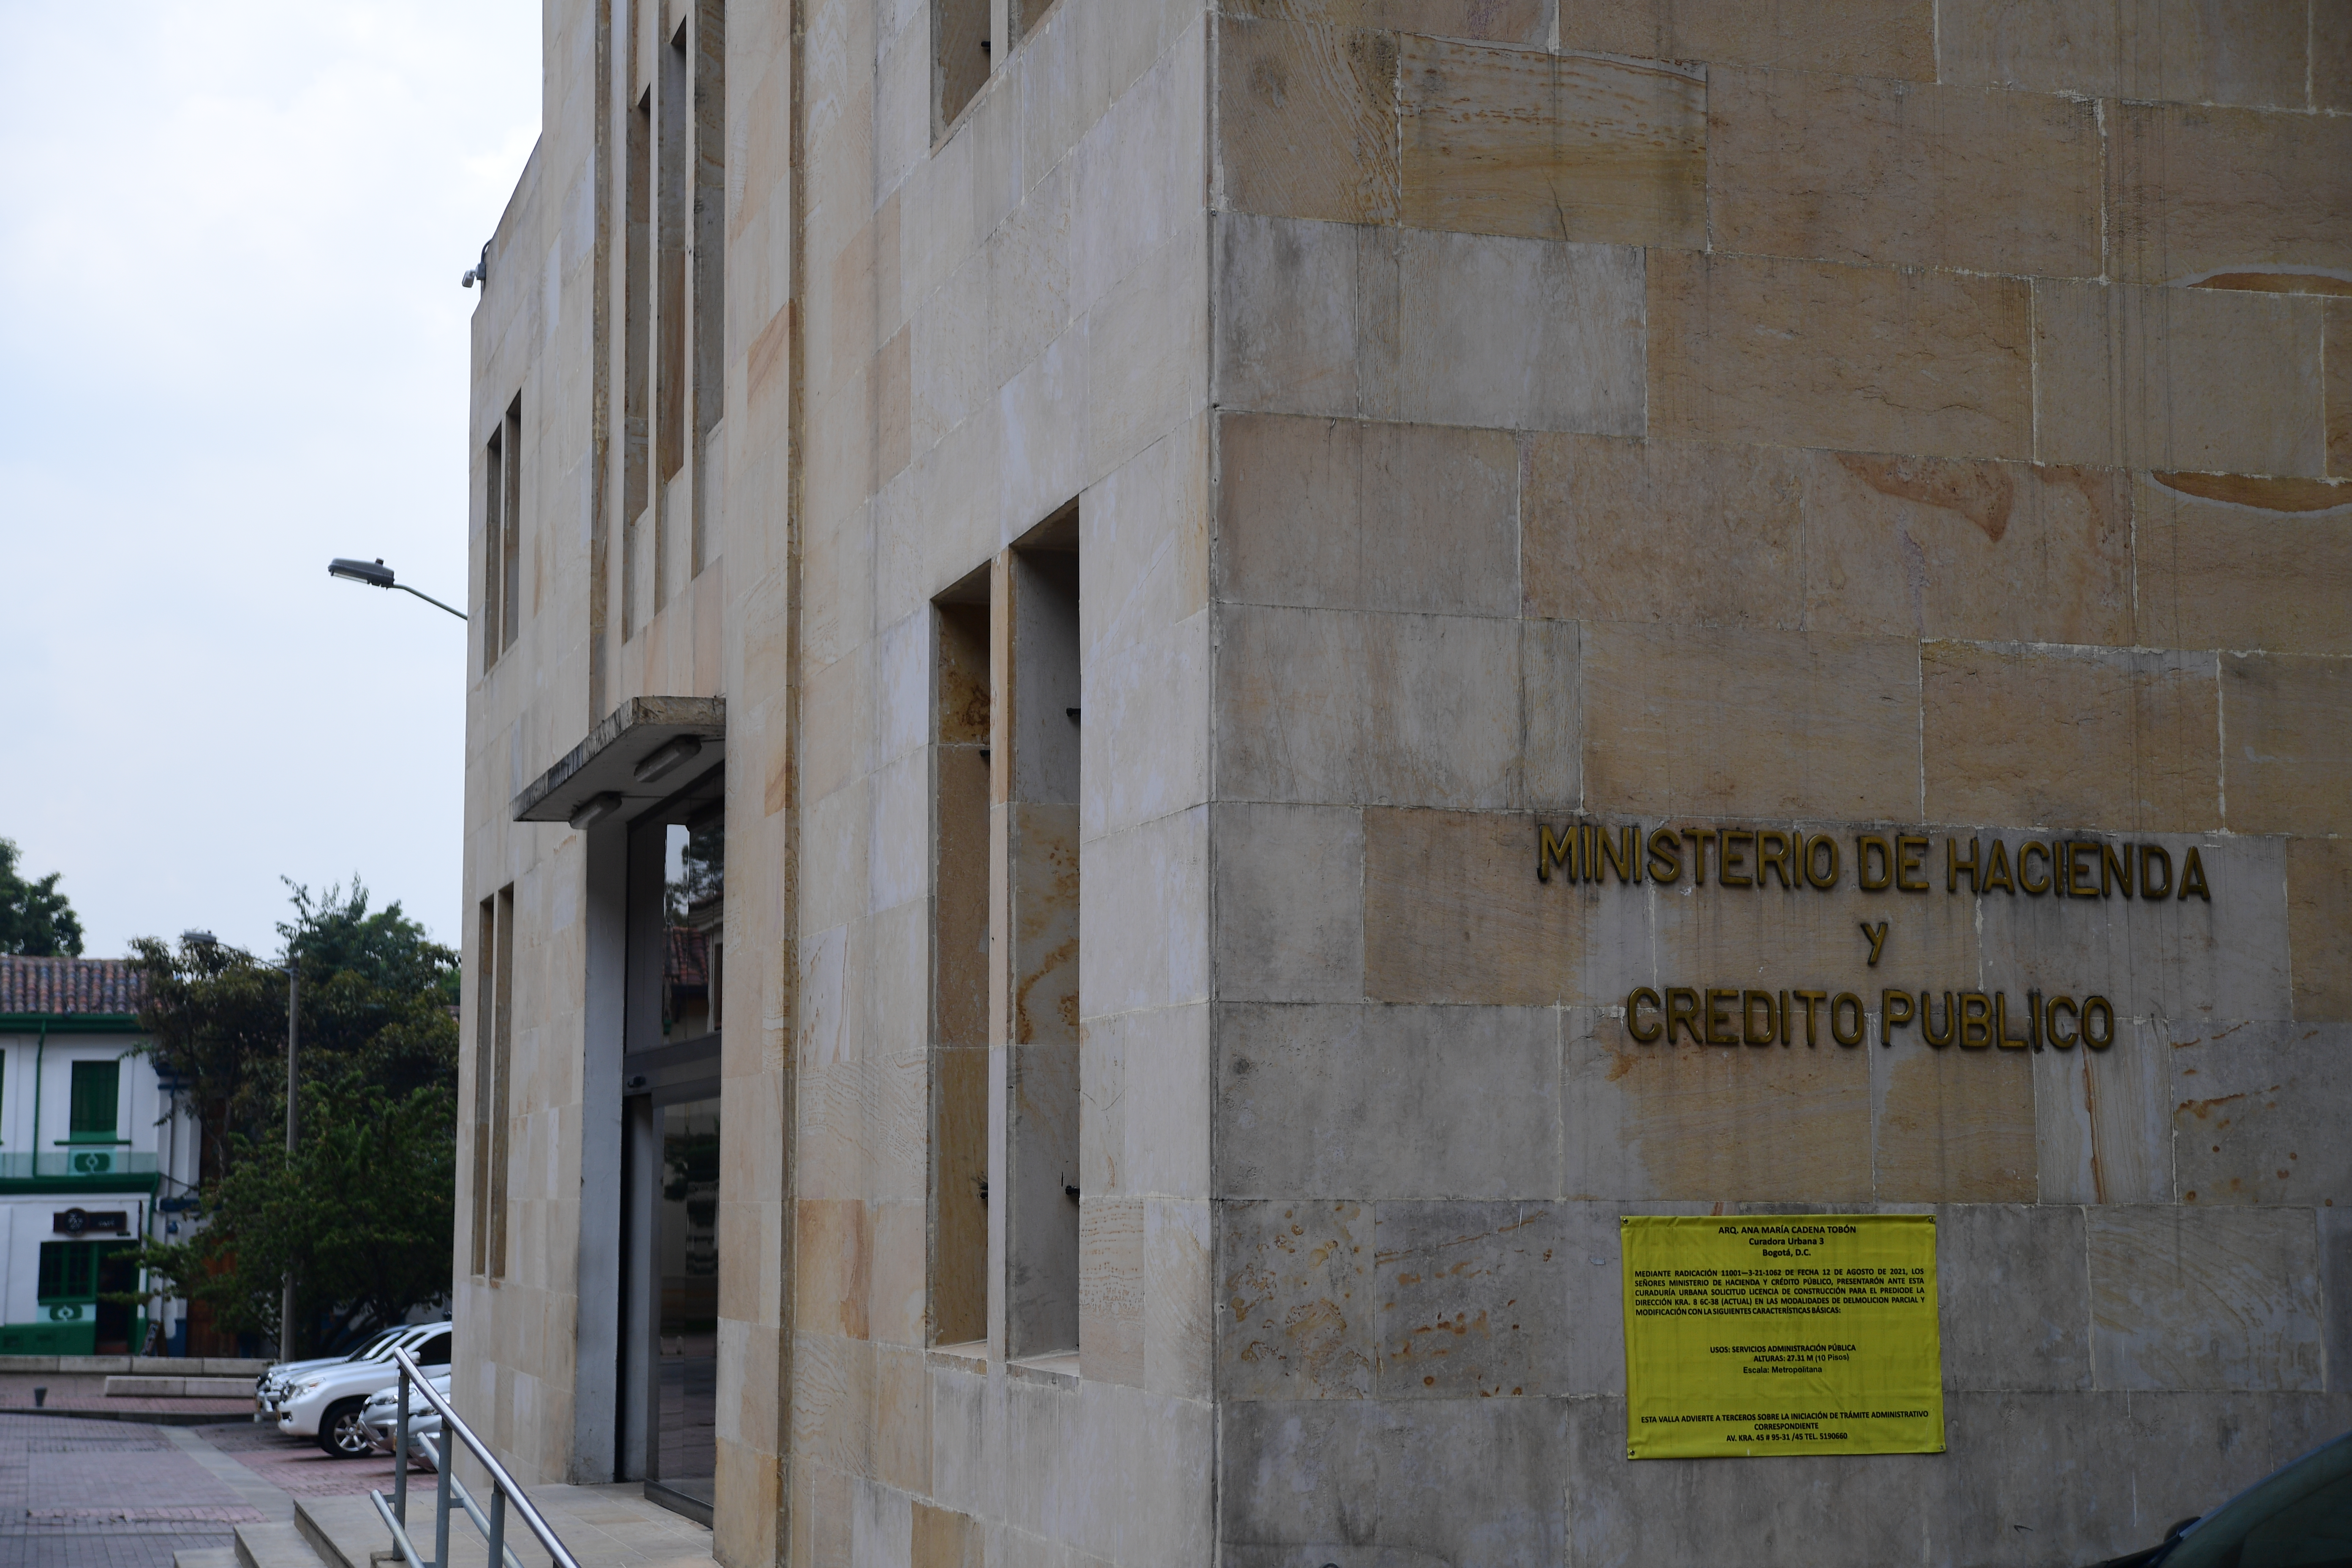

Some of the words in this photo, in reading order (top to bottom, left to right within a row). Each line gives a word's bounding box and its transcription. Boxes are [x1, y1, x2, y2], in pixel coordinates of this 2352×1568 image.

[1538, 824, 1840, 886] MINISTERIO
[1859, 835, 1930, 889] DE
[1948, 837, 2210, 900] HACIENDA
[1628, 986, 1864, 1046] CREDITO
[1881, 988, 2114, 1051] PUBLICO
[1718, 1226, 1739, 1235] ARQ.
[1761, 1225, 1790, 1234] MARÍA
[1827, 1224, 1856, 1233] TOBÓN
[1749, 1237, 1786, 1245] Curadora
[1788, 1237, 1817, 1245] Urbana
[1762, 1248, 1793, 1258] Bogotá,
[1675, 1269, 1718, 1277] RADICACIÓN
[1635, 1279, 1666, 1287] SEÑORES
[1771, 1277, 1799, 1286] CRÉDITO
[1803, 1277, 1833, 1286] PÚBLICO,
[1837, 1277, 1884, 1285] PRESENTARÓN
[1635, 1288, 1676, 1296] CURADURÍA
[1794, 1286, 1846, 1295] CONSTRUCCIÓN
[1636, 1298, 1672, 1306] DIRECCIÓN
[1721, 1298, 1752, 1306] (ACTUAL)
[1636, 1307, 1687, 1316] MODIFICACIÓN
[1713, 1307, 1752, 1315] SIGUIENTES
[1752, 1306, 1811, 1315] CARACTERÍSTICAS
[1811, 1305, 1841, 1314] BÁSICAS:
[1767, 1343, 1827, 1353] ADMINISTRACIÓN
[1828, 1343, 1856, 1352] PÚBLICA
[1815, 1354, 1826, 1362] (10
[1827, 1353, 1849, 1361] Pisos)
[1772, 1366, 1822, 1375] Metropolitana
[1791, 1411, 1828, 1420] INICIACIÓN
[1839, 1410, 1870, 1419] TRÁMITE
[1871, 1410, 1929, 1418] ADMINISTRATIVO
[1754, 1422, 1819, 1430] CORRESPONDIENTE
[1791, 1433, 1803, 1442] /45
